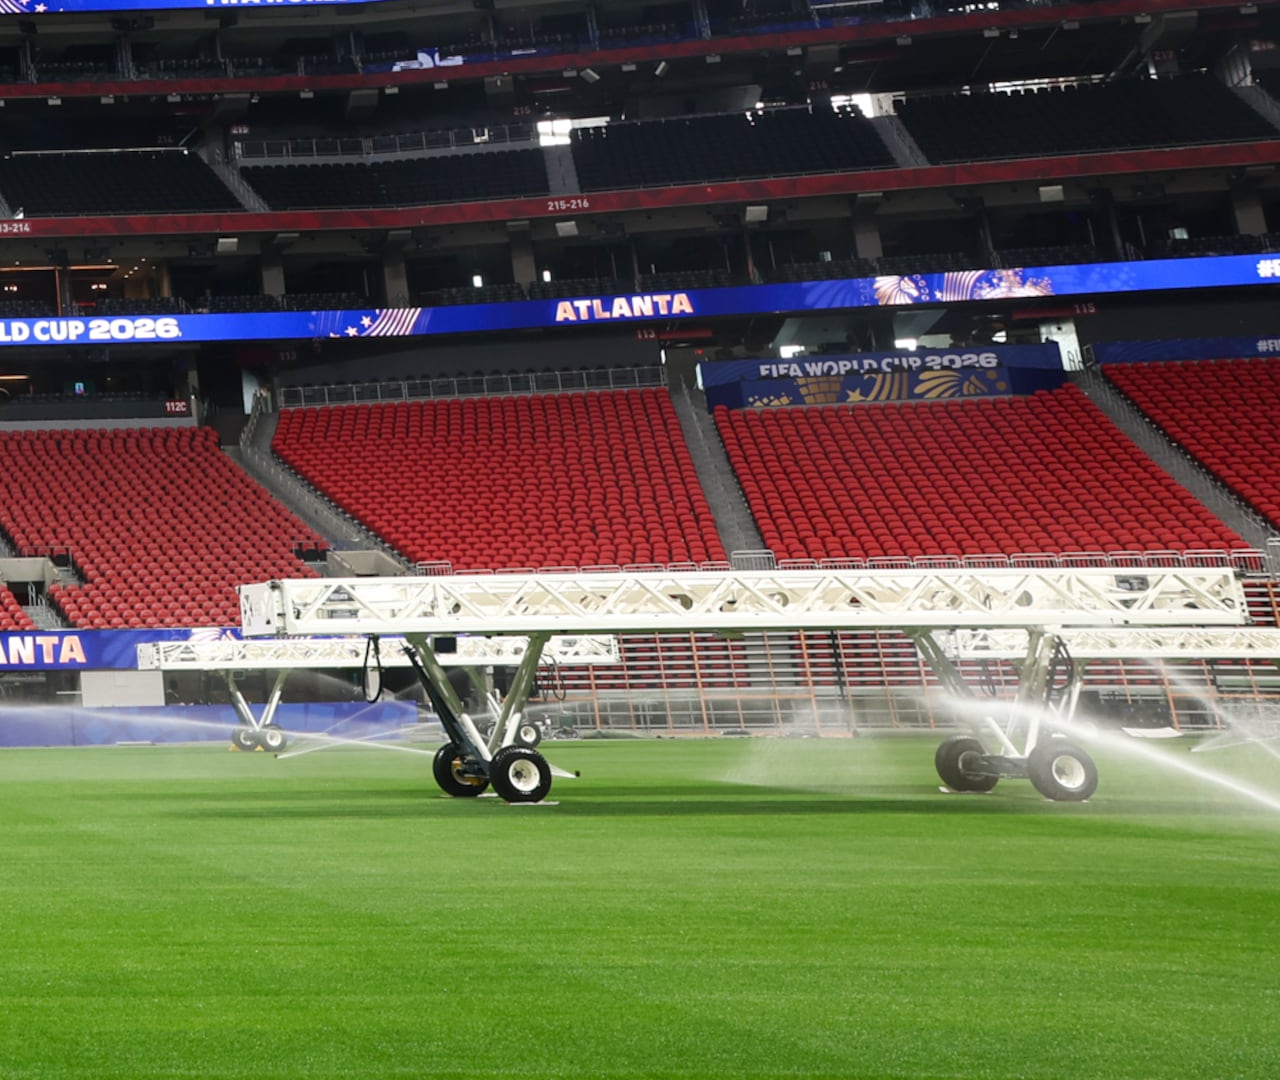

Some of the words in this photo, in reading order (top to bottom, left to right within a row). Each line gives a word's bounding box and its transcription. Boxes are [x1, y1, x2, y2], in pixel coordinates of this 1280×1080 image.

[547, 199, 589, 210] 215-216
[555, 294, 693, 321] ATLANTA
[33, 319, 85, 342] CUP
[89, 318, 178, 340] 2026
[759, 362, 804, 377] FIFA
[925, 353, 998, 370] 2026
[165, 402, 187, 412] 112C
